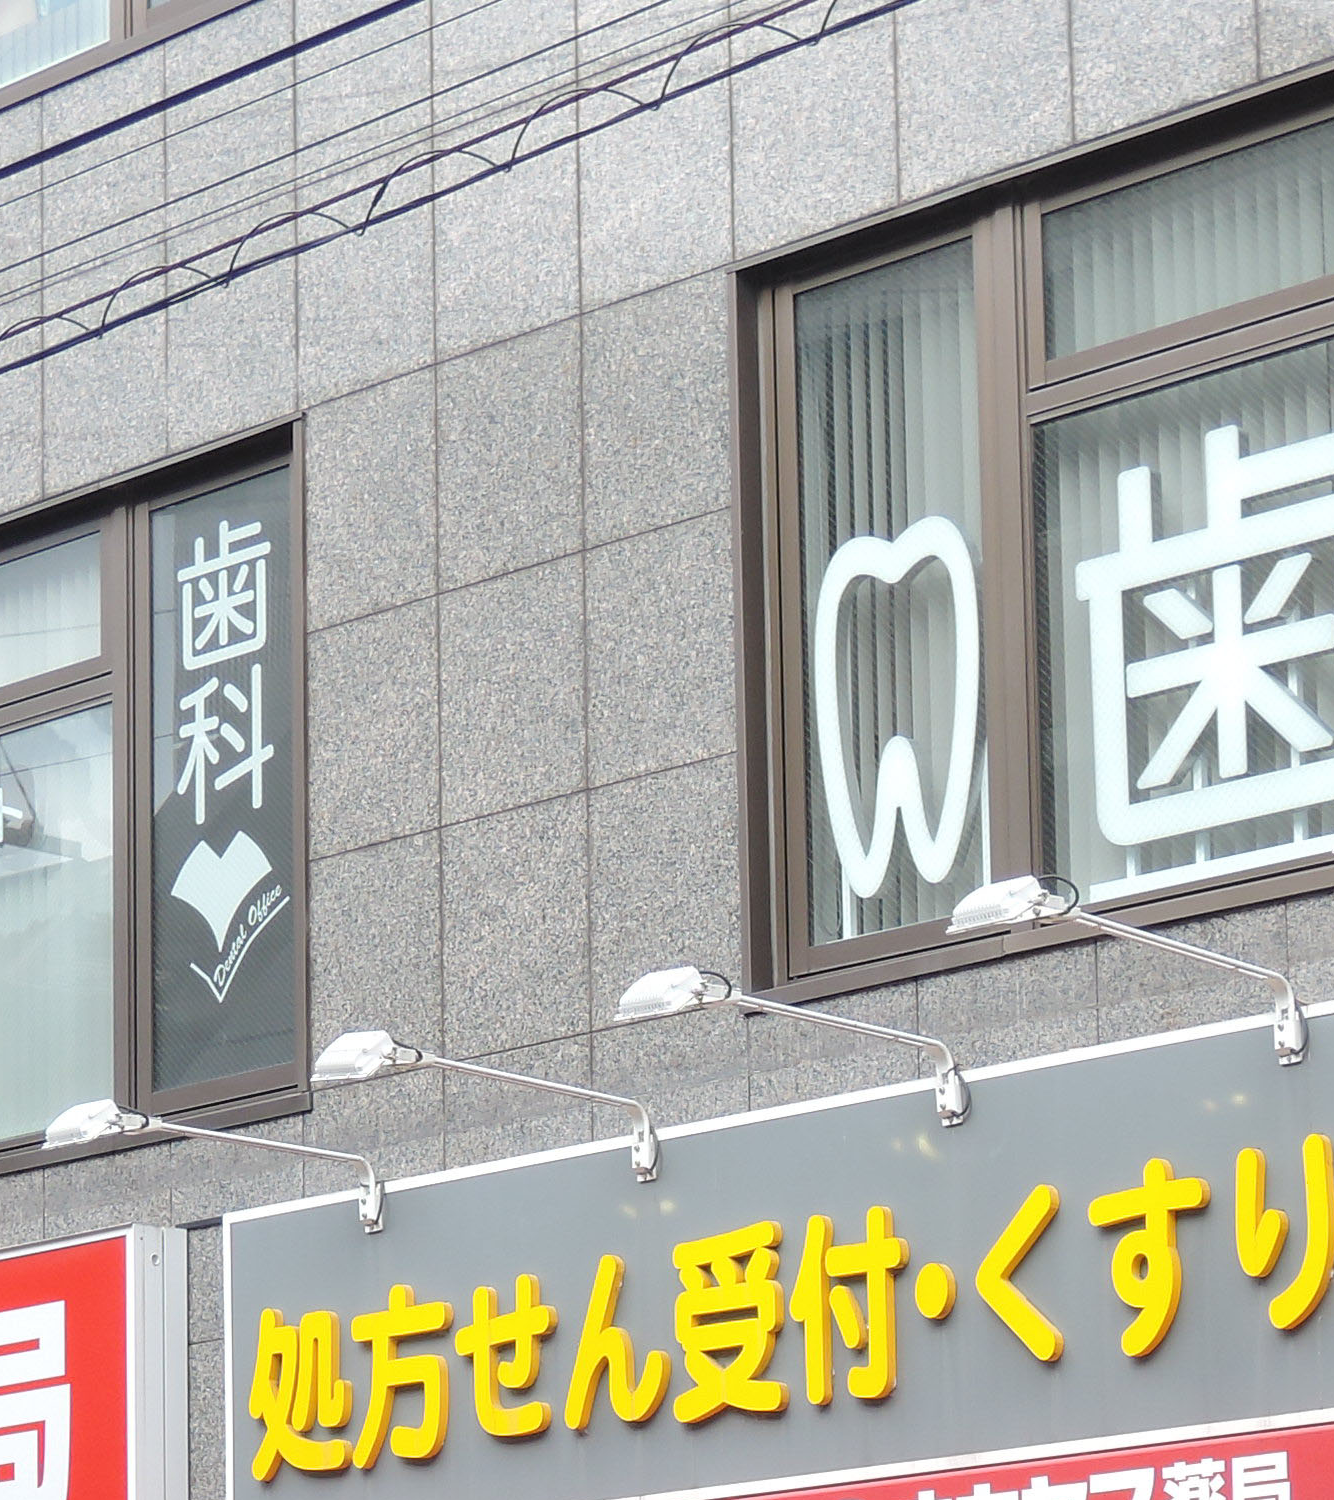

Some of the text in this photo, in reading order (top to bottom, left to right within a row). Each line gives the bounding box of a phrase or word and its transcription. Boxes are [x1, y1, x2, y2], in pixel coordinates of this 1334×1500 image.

[176, 519, 274, 825] 歯科
[213, 885, 282, 987] Dental Office
